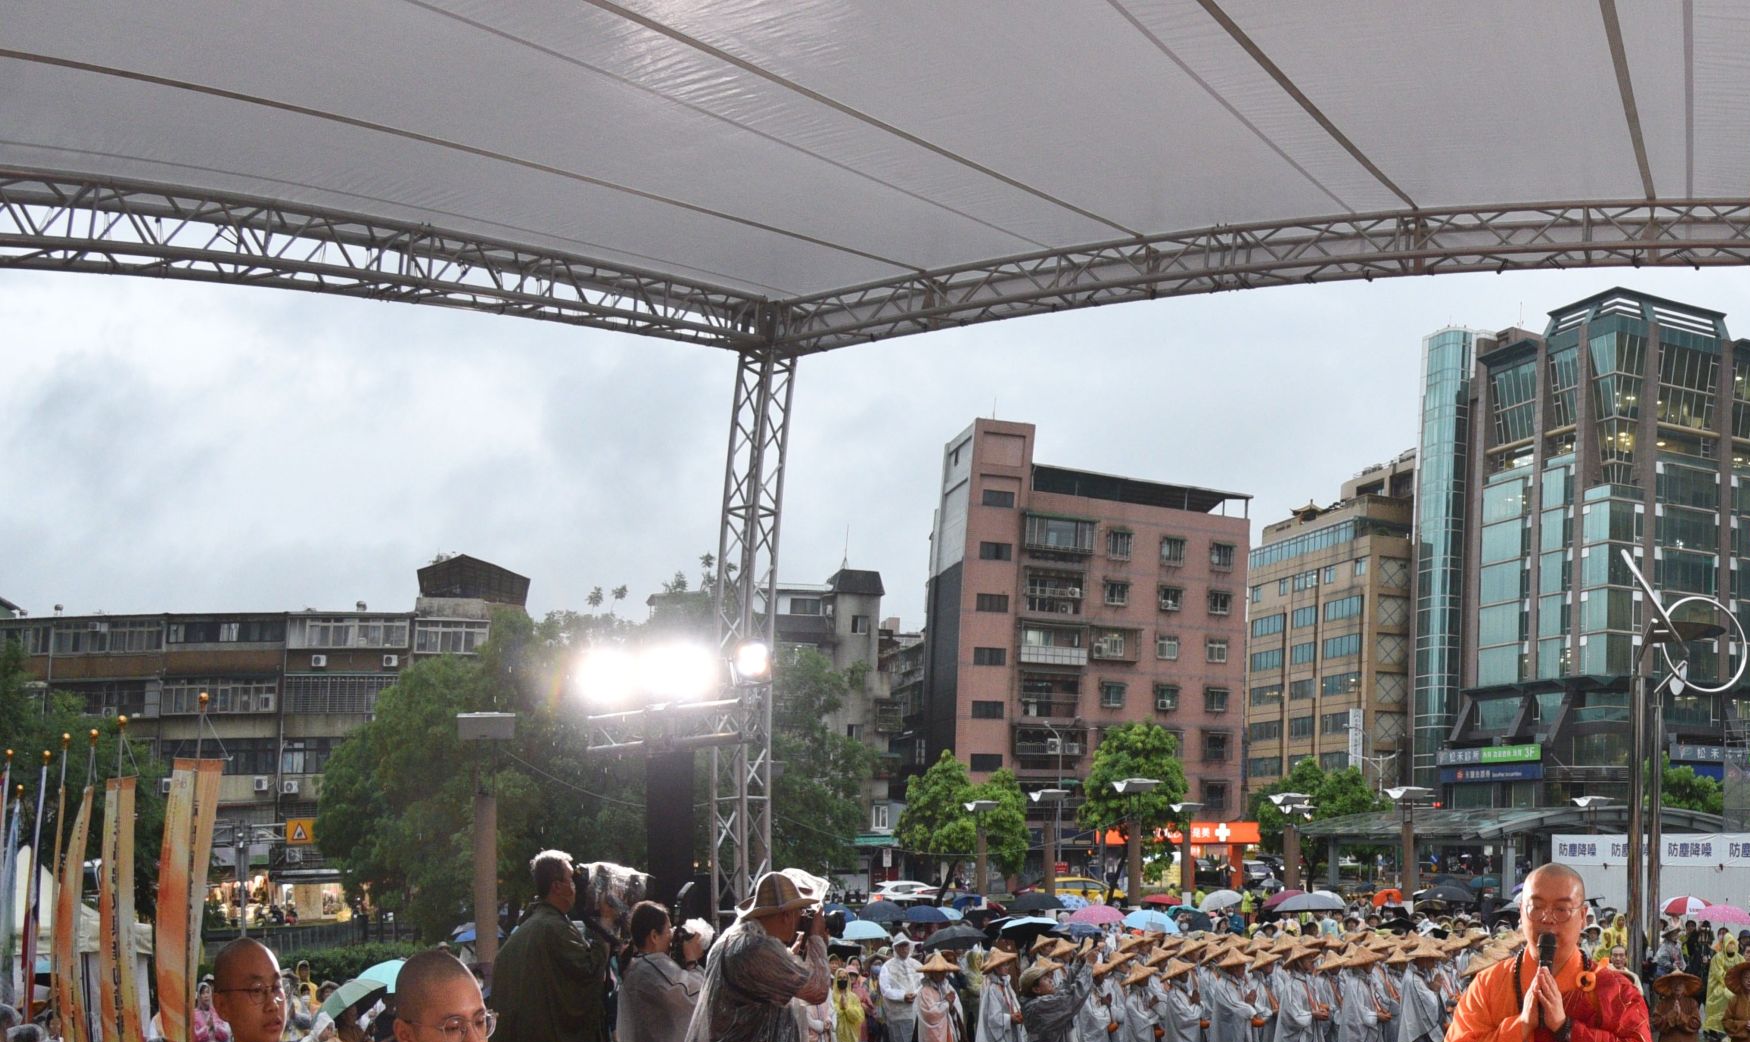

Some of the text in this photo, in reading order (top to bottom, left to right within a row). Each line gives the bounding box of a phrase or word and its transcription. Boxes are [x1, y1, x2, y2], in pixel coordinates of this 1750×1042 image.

[1524, 746, 1536, 758] 3F
[1558, 842, 1598, 858] 防塵降噪
[1668, 842, 1712, 858] 防塵降噪
